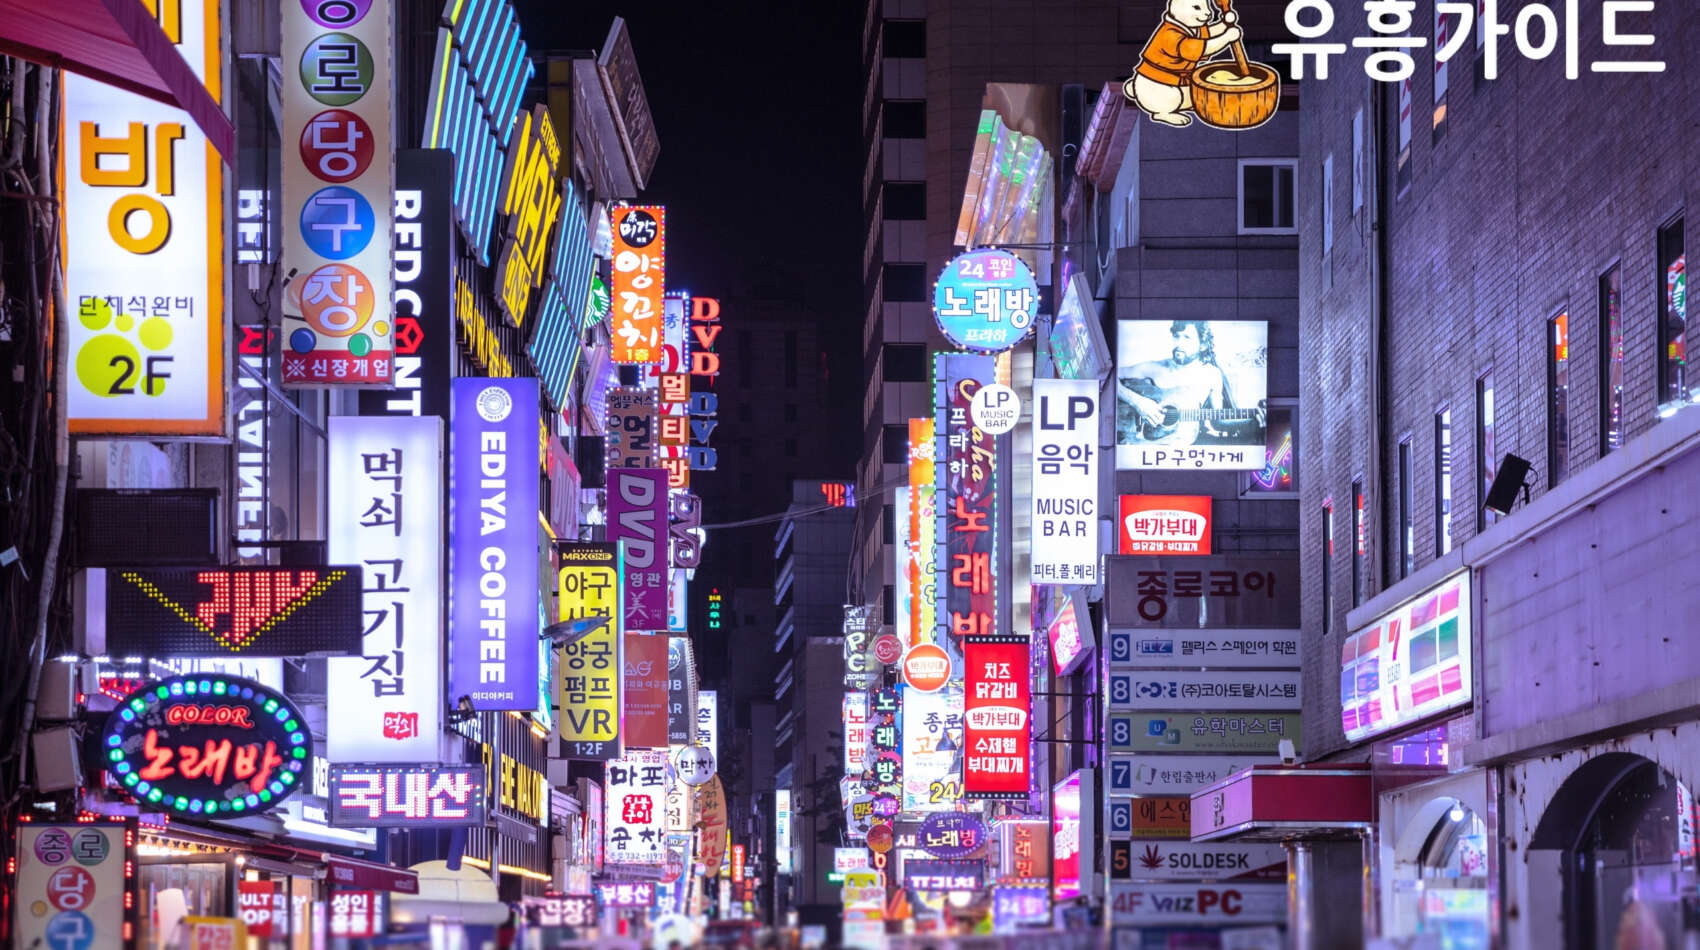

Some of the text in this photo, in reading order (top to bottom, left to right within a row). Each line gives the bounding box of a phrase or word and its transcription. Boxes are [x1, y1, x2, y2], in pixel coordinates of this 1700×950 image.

[504, 110, 561, 288] MAX
[959, 259, 985, 279] 24
[79, 295, 195, 318] 단체식완비
[615, 250, 661, 348] 양꼬치
[940, 287, 1034, 329] 노래방
[690, 296, 721, 377] DVD
[109, 355, 175, 395] 2F
[311, 358, 390, 378] 신장개업
[983, 391, 1011, 410] LP
[980, 411, 1015, 419] MUSIC
[985, 420, 1008, 428] BAR
[1040, 396, 1096, 431] LP
[688, 391, 719, 471] DVD
[950, 407, 969, 480] 프라하
[1037, 444, 1094, 476] 음악
[1142, 449, 1244, 468] LP 구멍가게
[479, 431, 506, 536] EDIYA
[1036, 498, 1094, 516] MUSIC
[618, 472, 656, 569] DVD
[1043, 520, 1088, 537] BAR
[1134, 519, 1198, 536] 박가부대
[360, 448, 410, 698] 먹쇠 고기집
[565, 571, 612, 600] 야구
[625, 590, 650, 620] 美
[1137, 571, 1277, 622] 종로코아
[479, 546, 506, 684] COFFEE
[565, 641, 613, 670] 양궁
[1112, 638, 1128, 658] 9
[1222, 640, 1269, 656] 스페인어
[1272, 640, 1297, 656] 학원
[984, 662, 1011, 679] 치즈
[471, 691, 514, 701] 이디야커피
[565, 677, 613, 704] 펌프
[975, 682, 1018, 699] 닭갈비
[1112, 680, 1128, 698] 8
[1181, 683, 1297, 699] (주)코아토탈시스템
[167, 704, 254, 729] COLOR
[567, 709, 612, 735] VR
[971, 711, 1020, 726] 박가부대
[848, 709, 865, 763] 노래방
[876, 692, 897, 783] 노래방
[1112, 722, 1128, 743] 8
[1191, 718, 1285, 737] 유학마스터
[975, 737, 1017, 754] 수제햄
[138, 728, 283, 794] 노래방
[968, 756, 1024, 774] 부대찌개
[609, 765, 664, 787] 마포
[1114, 765, 1129, 785] 7
[338, 772, 476, 820] 국내산
[1113, 807, 1128, 828] 6
[42, 833, 104, 863] 종로
[611, 826, 665, 850] 곱창
[926, 829, 977, 848] 노래방
[1113, 850, 1129, 870] 5
[1168, 853, 1250, 869] SOLDESK
[238, 893, 271, 905] ULT
[331, 894, 368, 913] 성인
[1112, 892, 1143, 913] 4F
[1197, 889, 1243, 916] PC
[242, 908, 271, 925] OP
